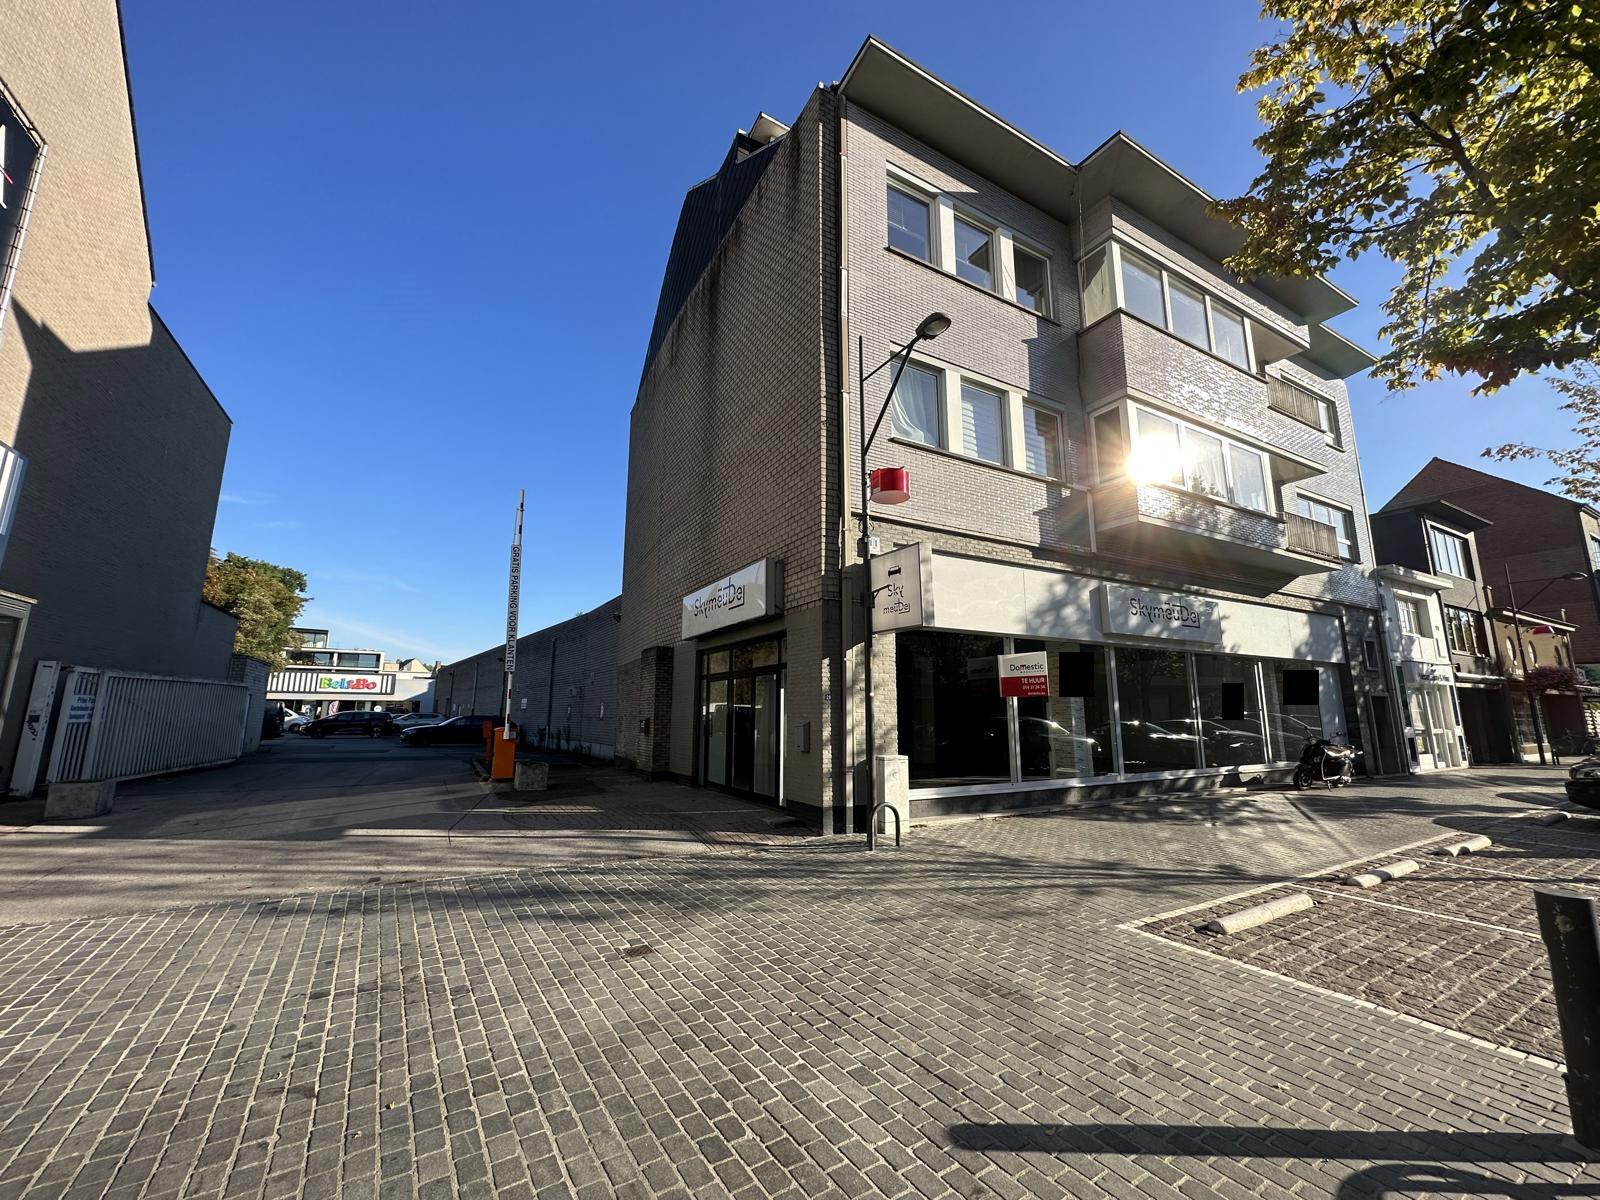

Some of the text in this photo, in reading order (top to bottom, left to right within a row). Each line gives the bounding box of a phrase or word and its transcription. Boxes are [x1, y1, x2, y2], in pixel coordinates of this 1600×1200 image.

[888, 582, 904, 597] Sky
[506, 546, 521, 671] GRATIS PARKING VOOR KLANTEN
[1009, 663, 1044, 671] Domestic
